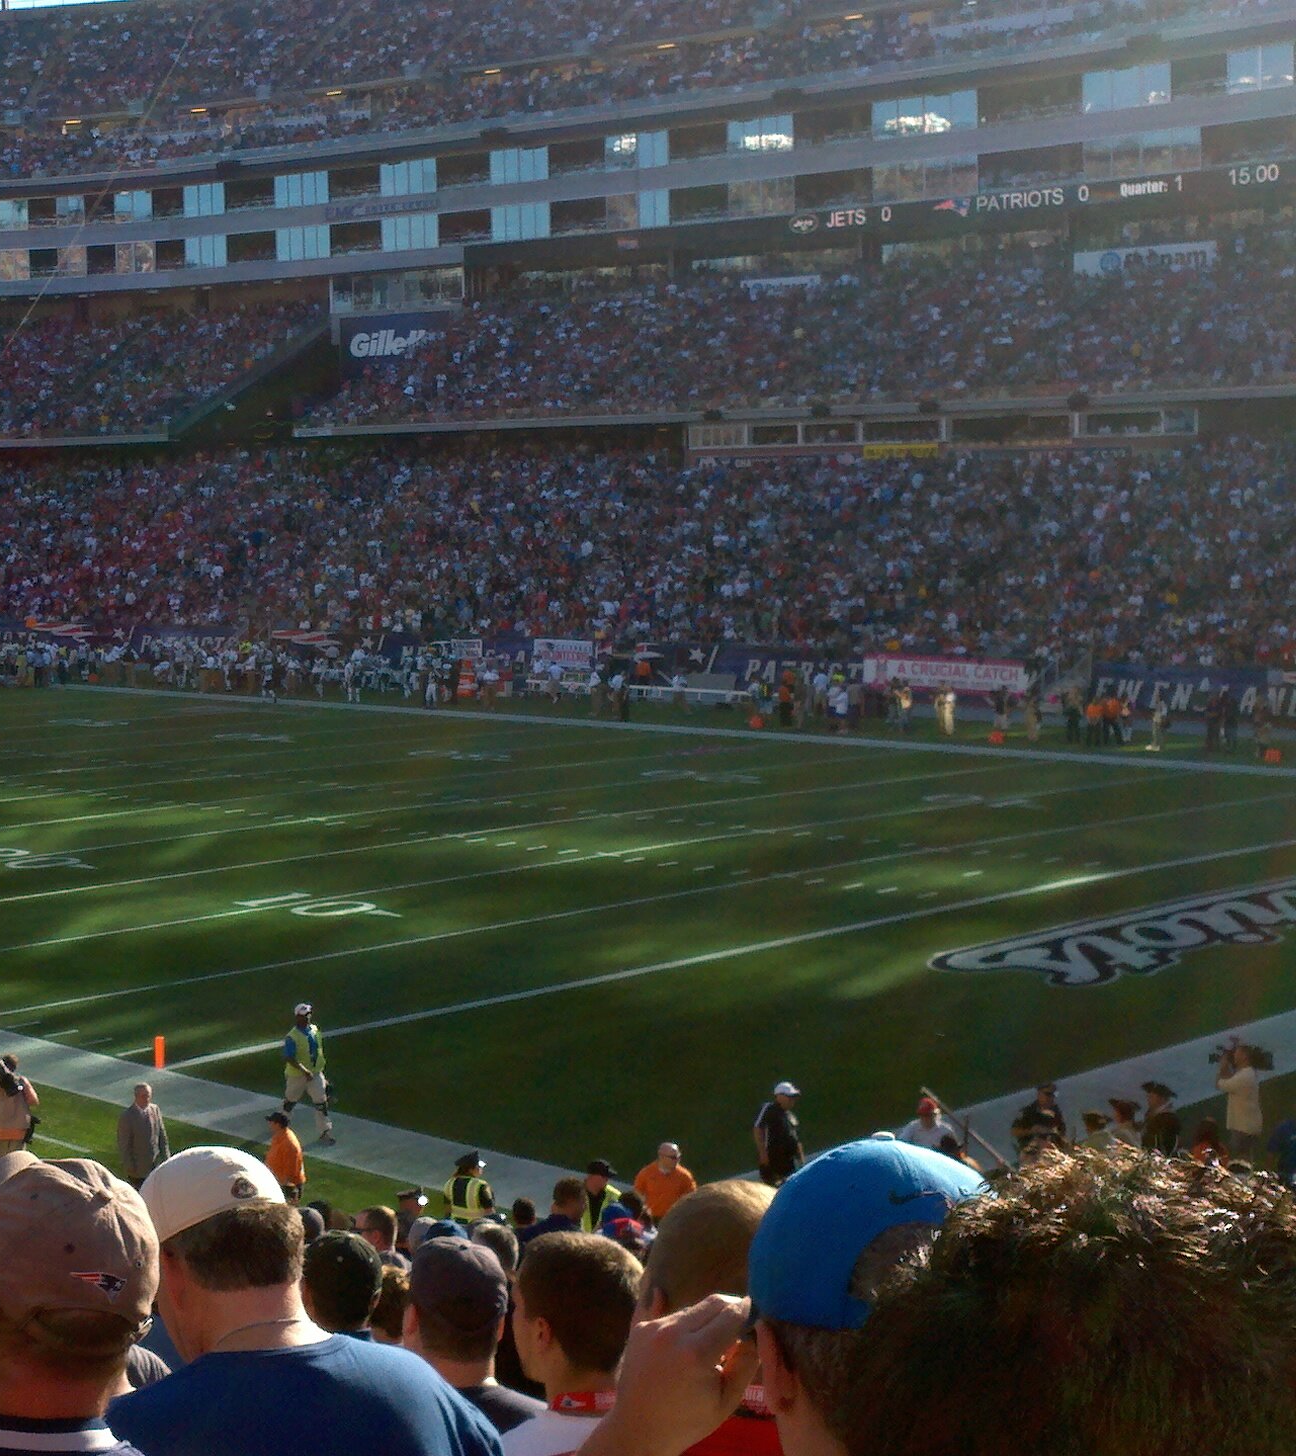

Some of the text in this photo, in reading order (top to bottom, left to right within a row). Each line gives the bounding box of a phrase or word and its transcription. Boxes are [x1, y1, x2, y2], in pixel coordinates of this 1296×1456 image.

[826, 209, 866, 228] JETS
[881, 206, 892, 222] 0
[976, 188, 1064, 212] PATRIOTS
[1078, 184, 1089, 202] 0
[1119, 181, 1168, 198] Quarter:
[1174, 175, 1183, 192] 1
[897, 662, 1019, 681] A CRUCIAL CATCH
[233, 892, 377, 917] 10
